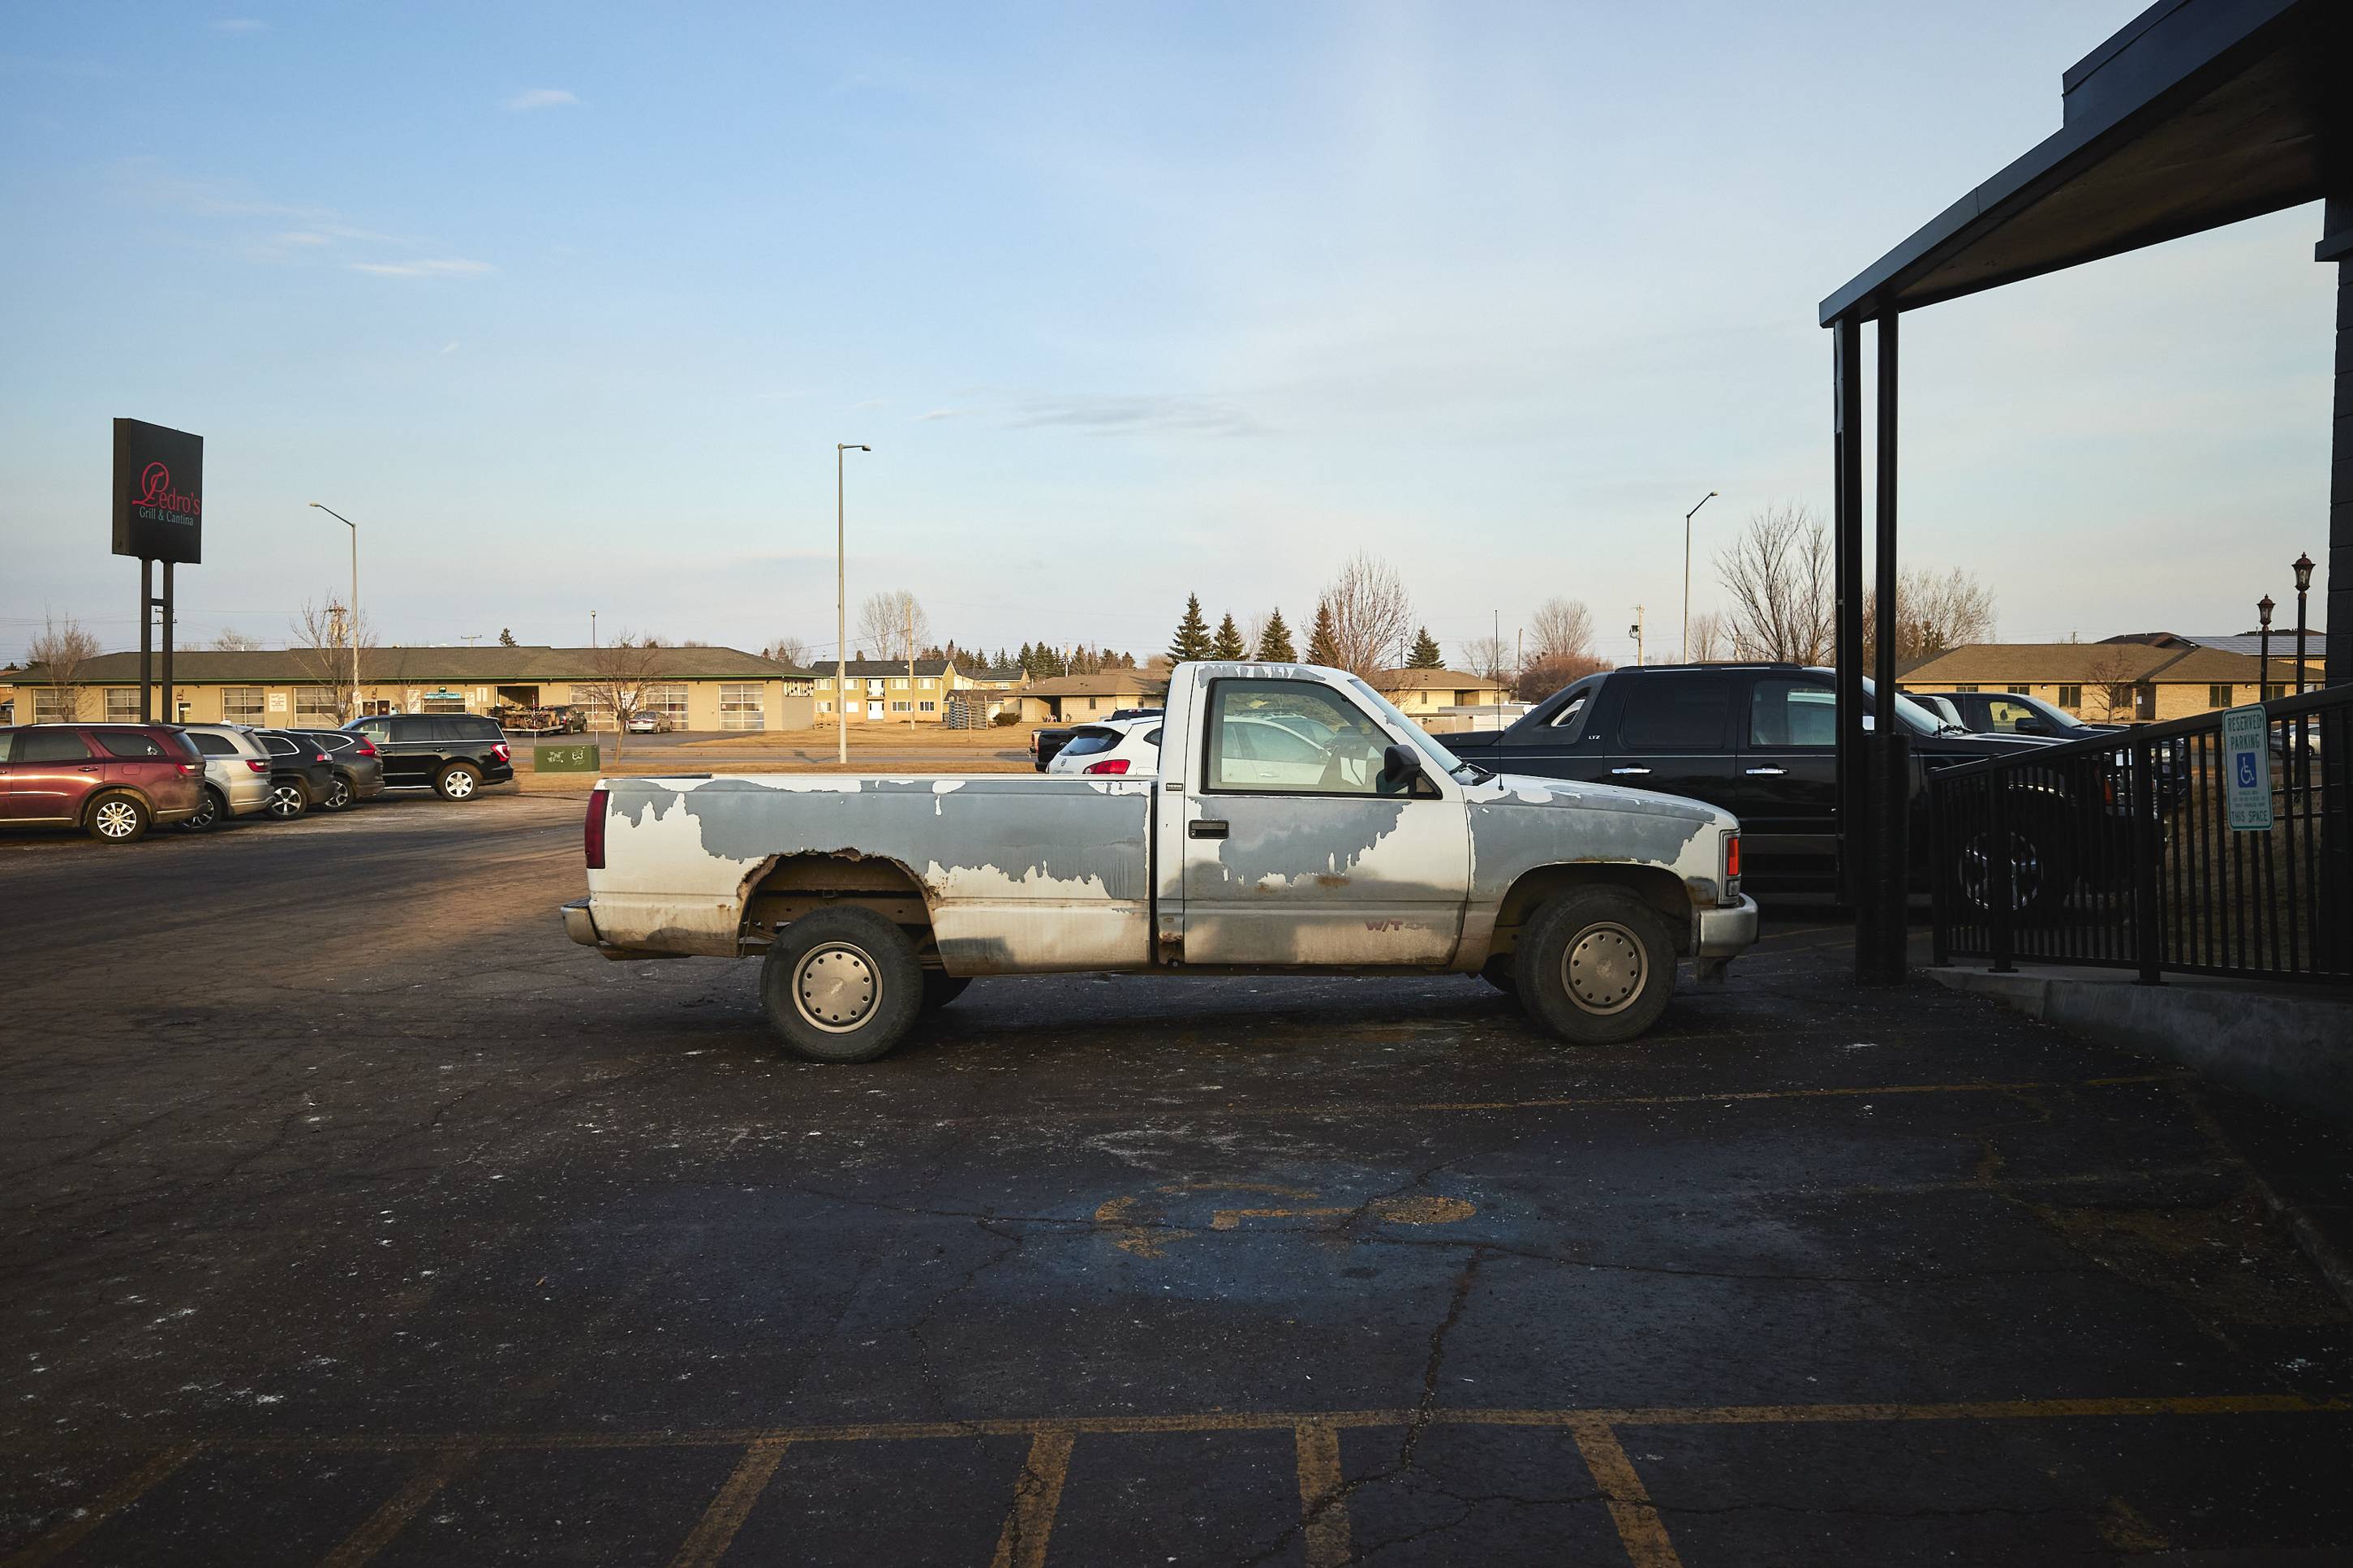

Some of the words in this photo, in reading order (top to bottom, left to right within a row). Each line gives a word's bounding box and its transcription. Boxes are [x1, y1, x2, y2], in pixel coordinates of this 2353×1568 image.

[131, 461, 200, 514] Pedro's
[140, 506, 156, 520] Grill
[157, 511, 164, 521] &
[166, 512, 194, 526] Cantina
[2227, 715, 2262, 732] RESERVED
[2230, 734, 2260, 750] PARKING
[2231, 811, 2245, 823] THIS
[2248, 810, 2268, 823] SPACE
[1365, 920, 1403, 932] W/T
